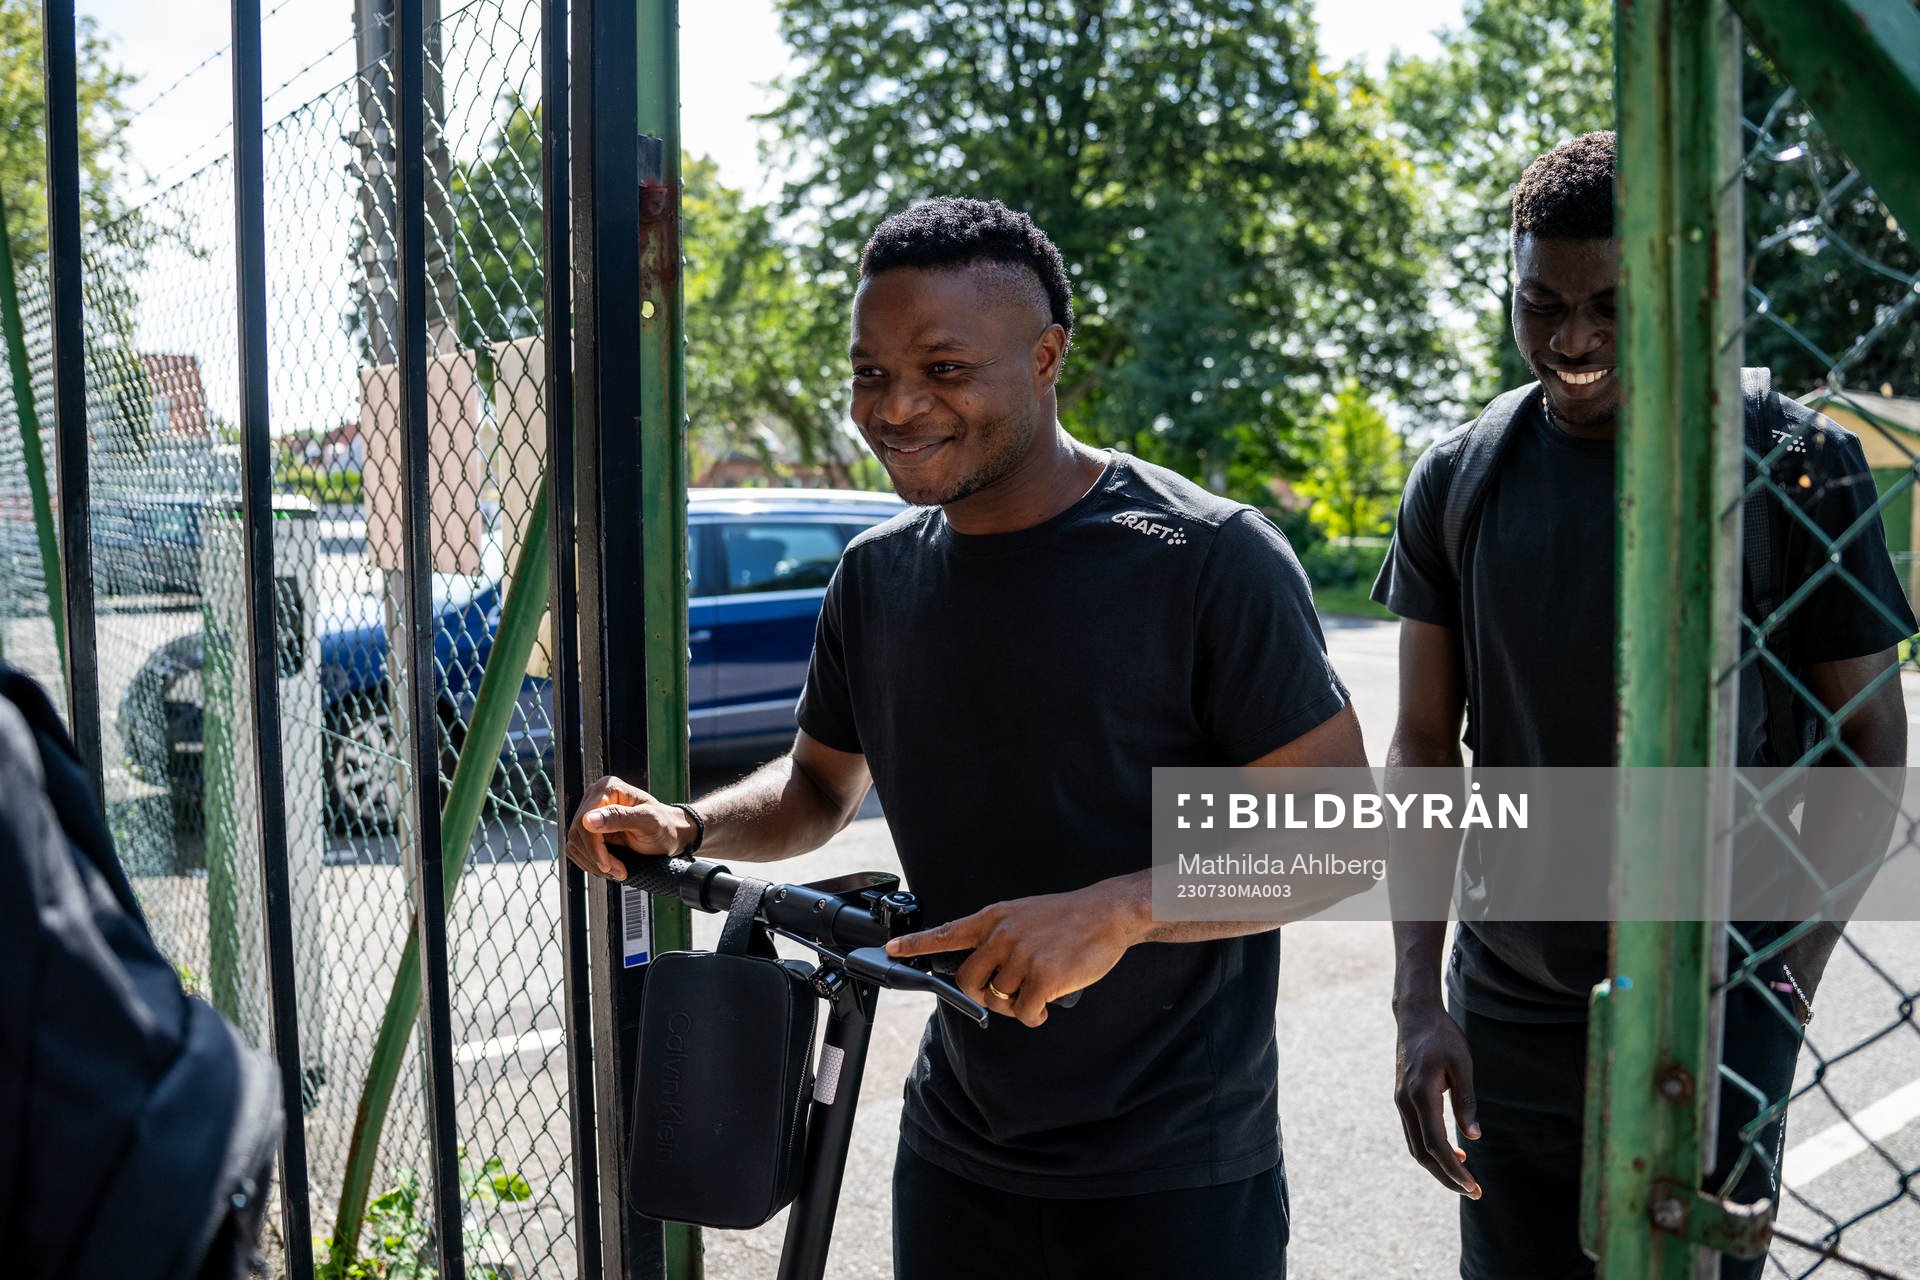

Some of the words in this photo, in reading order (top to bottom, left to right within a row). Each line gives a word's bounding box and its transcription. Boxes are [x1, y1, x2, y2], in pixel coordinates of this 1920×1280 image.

[1111, 512, 1174, 539] CRAFT
[663, 1010, 693, 1095] Calvin
[655, 1101, 684, 1163] Klein
